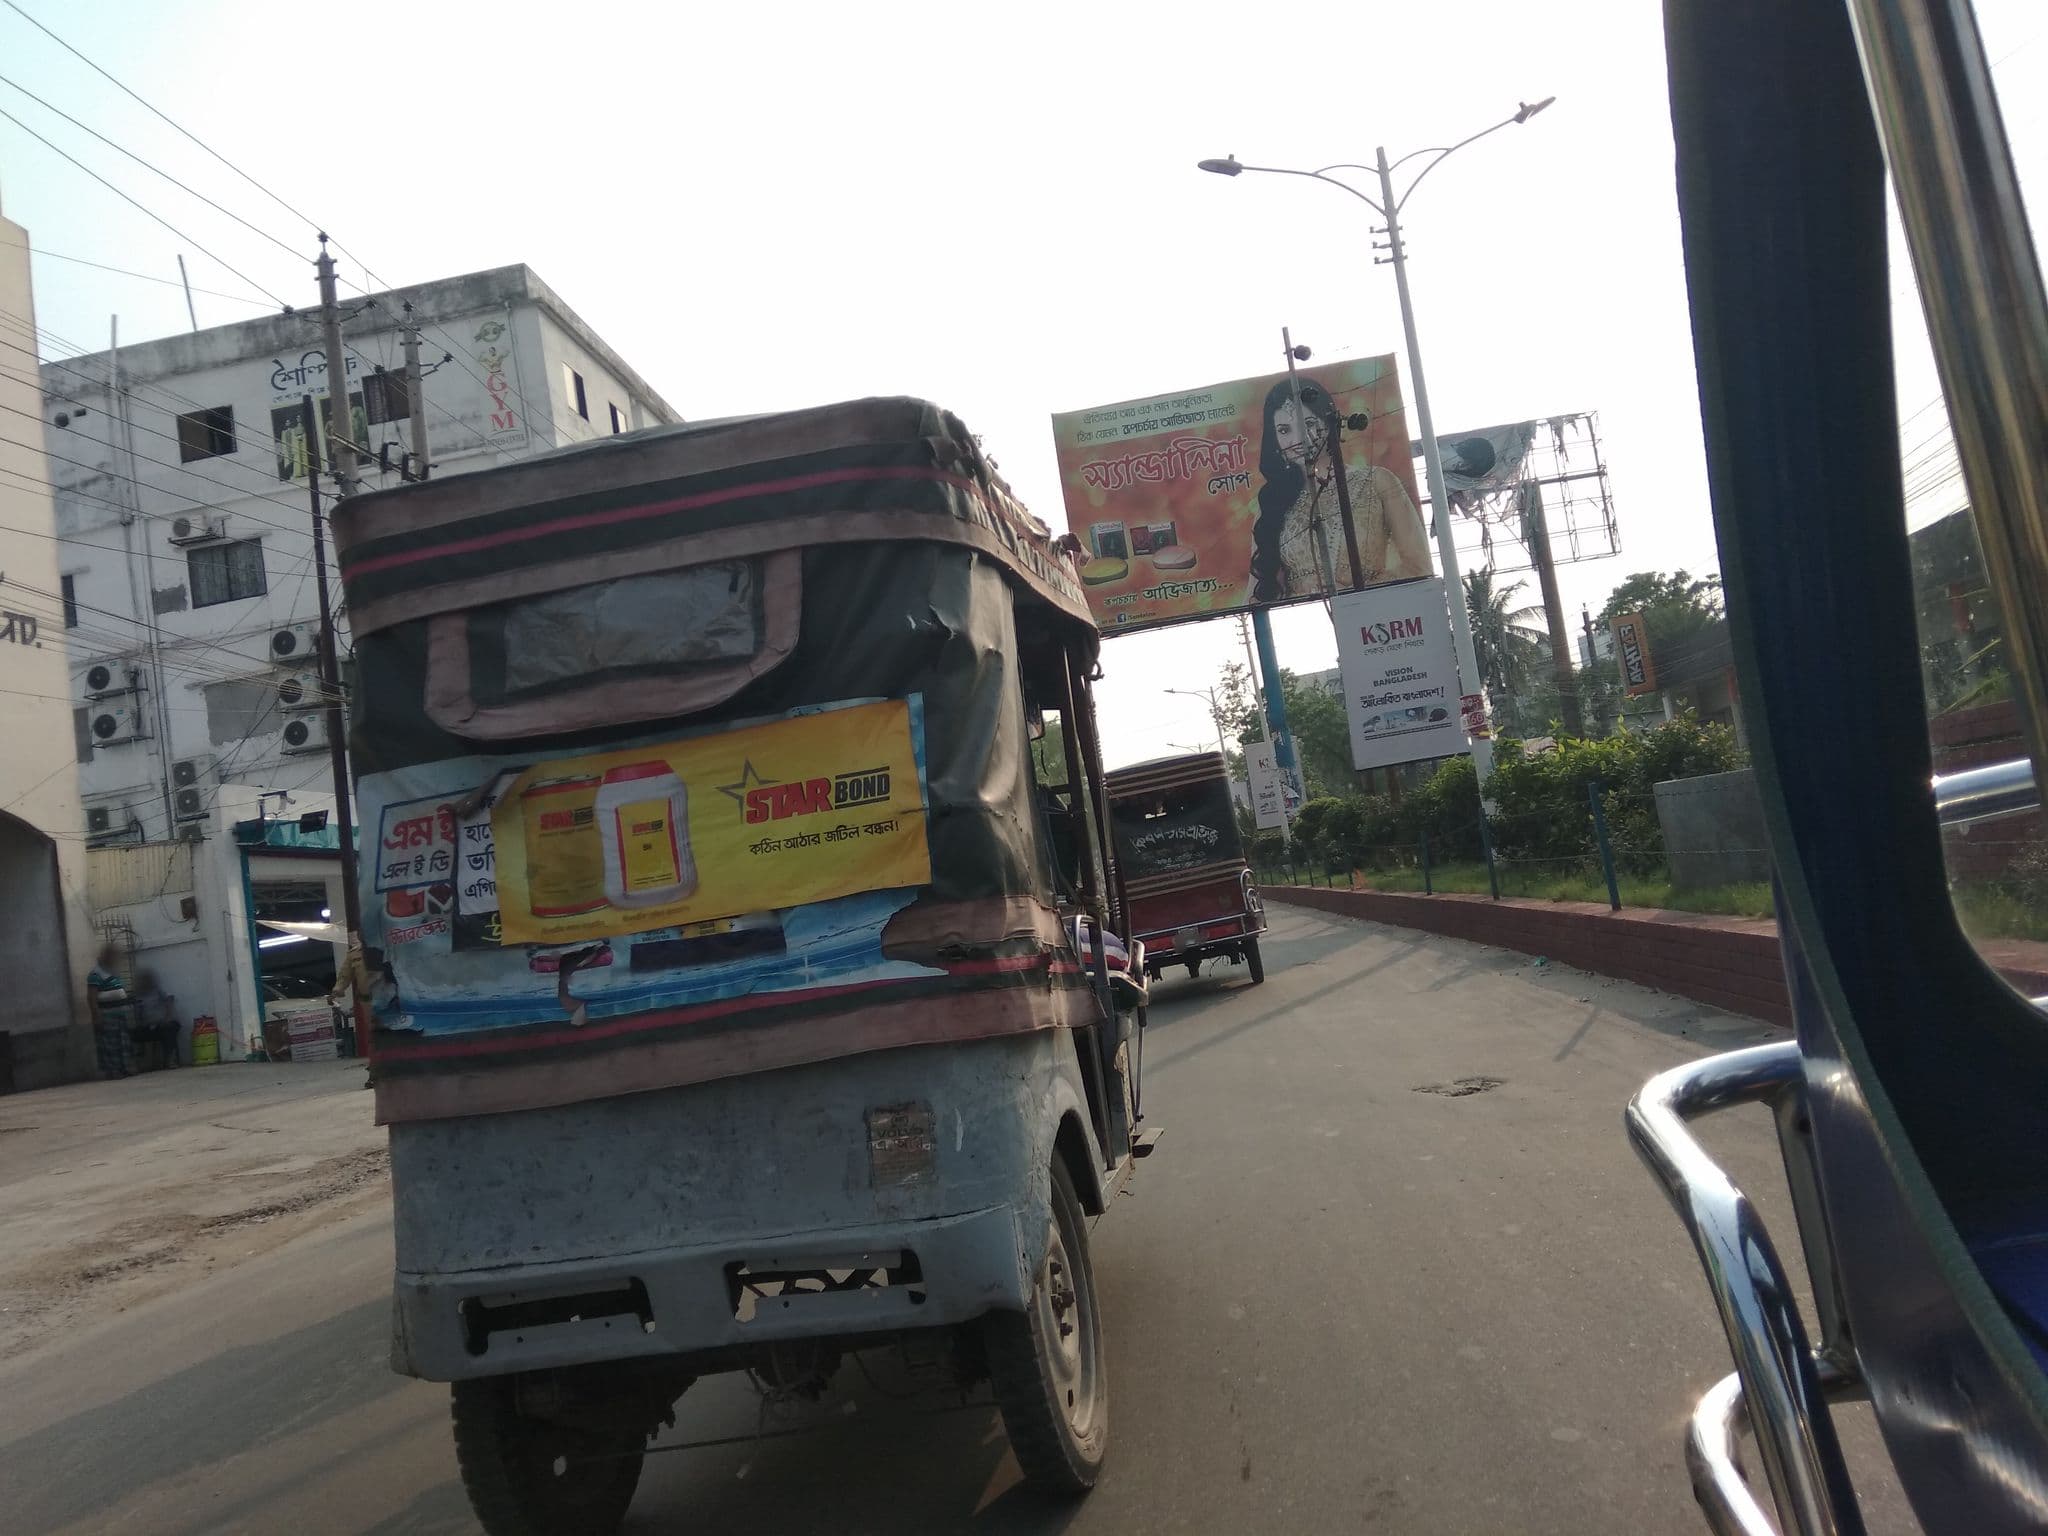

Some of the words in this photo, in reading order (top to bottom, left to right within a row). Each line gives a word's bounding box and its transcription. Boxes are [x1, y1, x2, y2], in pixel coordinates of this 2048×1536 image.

[487, 372, 515, 432] GYM
[1207, 472, 1252, 495] সোপ
[1360, 616, 1425, 646] KSRM
[1373, 671, 1428, 687] BANGLADESH
[1385, 666, 1414, 677] VISION
[746, 777, 833, 824] STAR
[835, 773, 890, 803] BOND
[384, 814, 434, 850] এম
[749, 838, 781, 856] কঠিন
[784, 832, 820, 850] আঠার
[824, 824, 860, 843] জটিল
[382, 860, 411, 880] এল
[413, 854, 426, 876] ই
[429, 849, 450, 873] ডি
